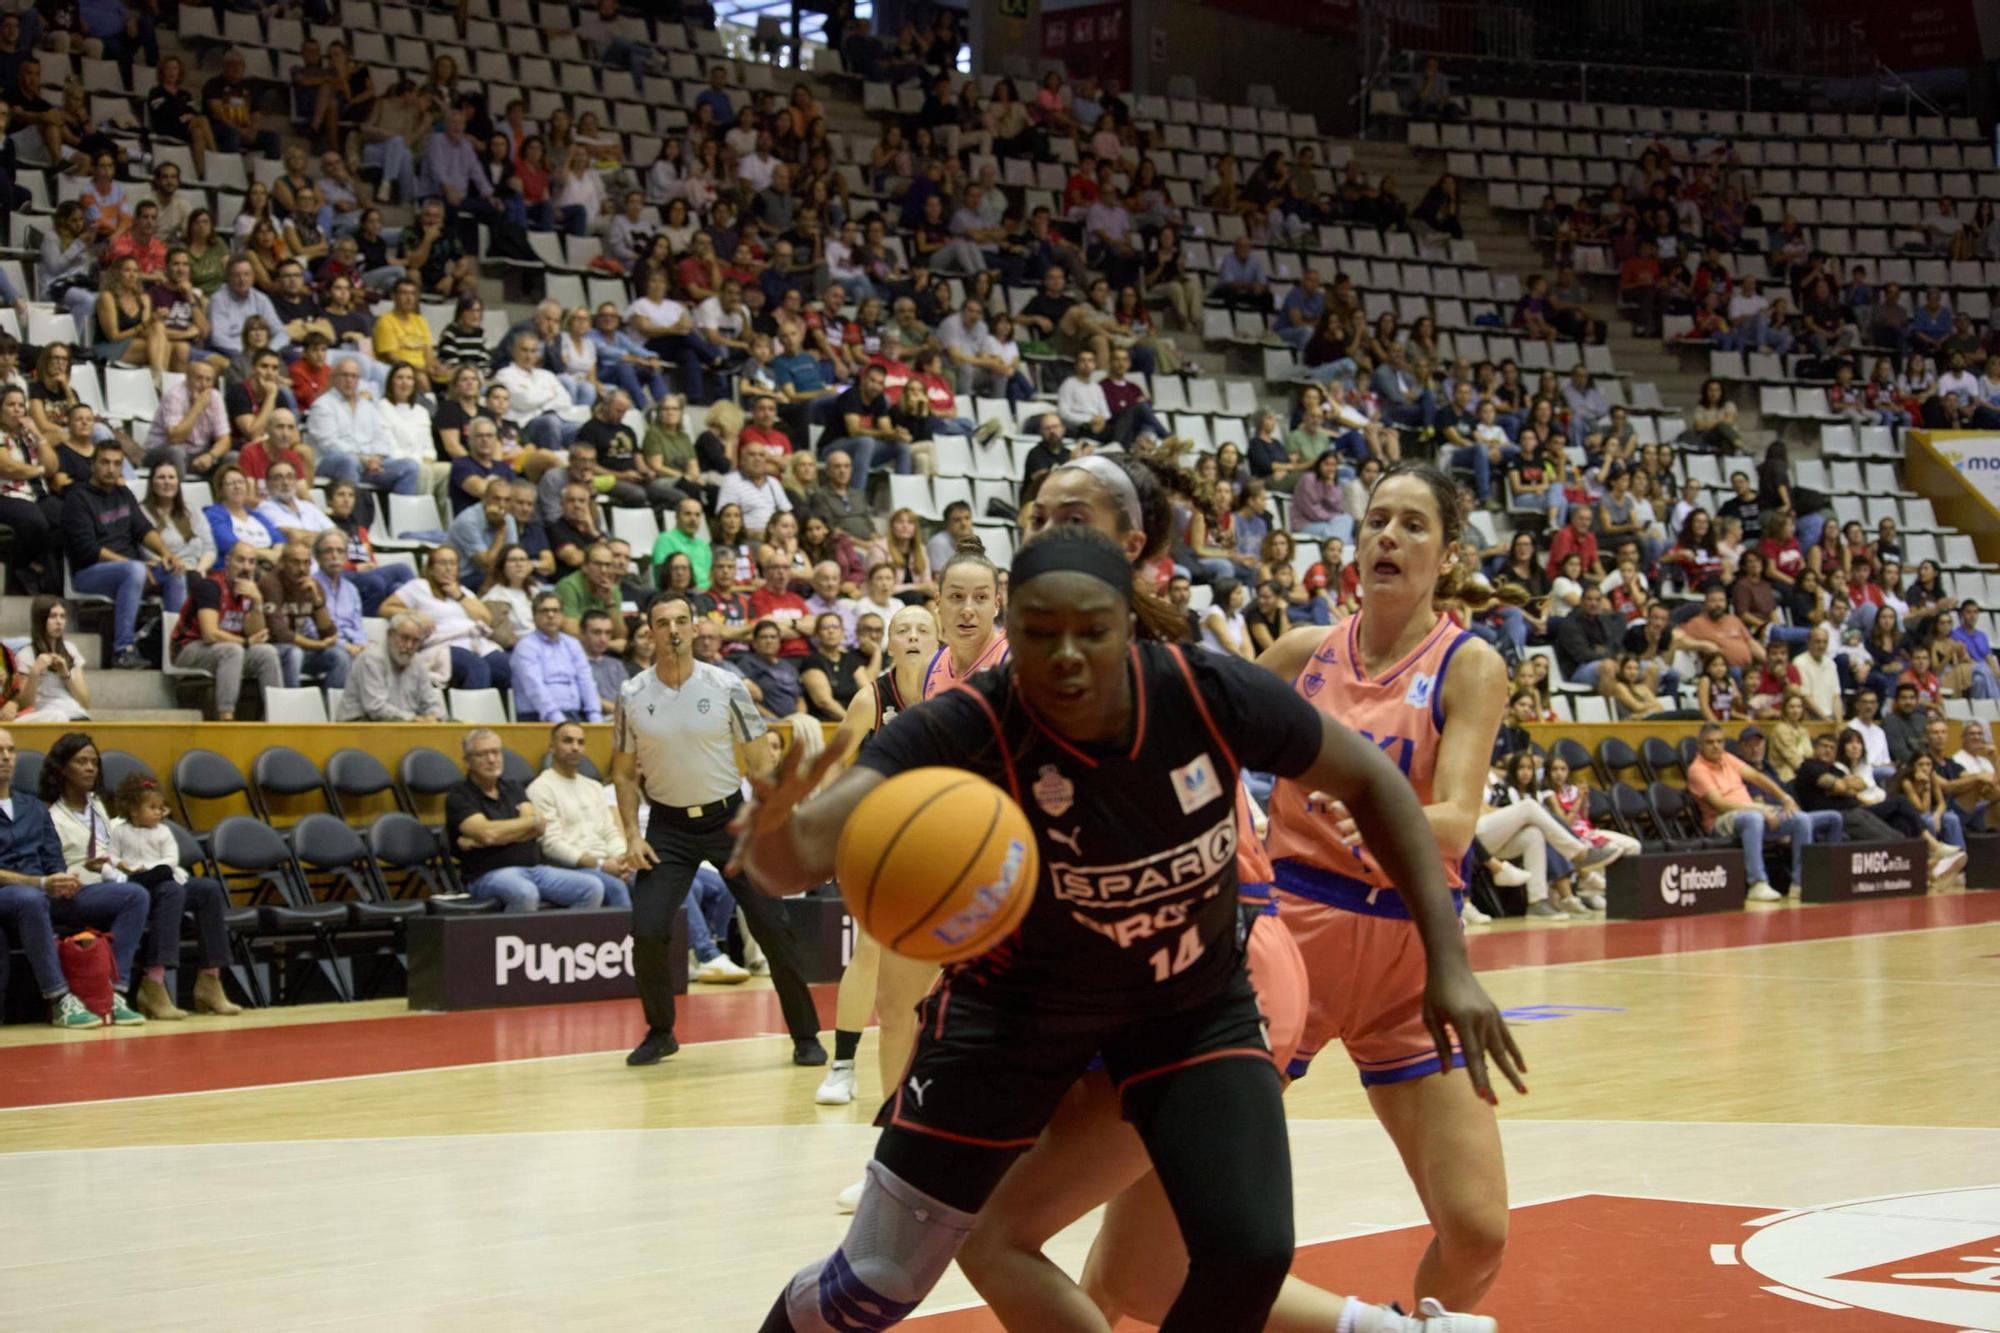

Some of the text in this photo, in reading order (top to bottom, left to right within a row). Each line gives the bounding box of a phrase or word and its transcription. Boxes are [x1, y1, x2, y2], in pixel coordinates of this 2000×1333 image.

[1061, 851, 1204, 900] SPAR
[1680, 865, 1728, 891] infosoft
[495, 934, 636, 986] Punset
[1148, 923, 1207, 984] 14
